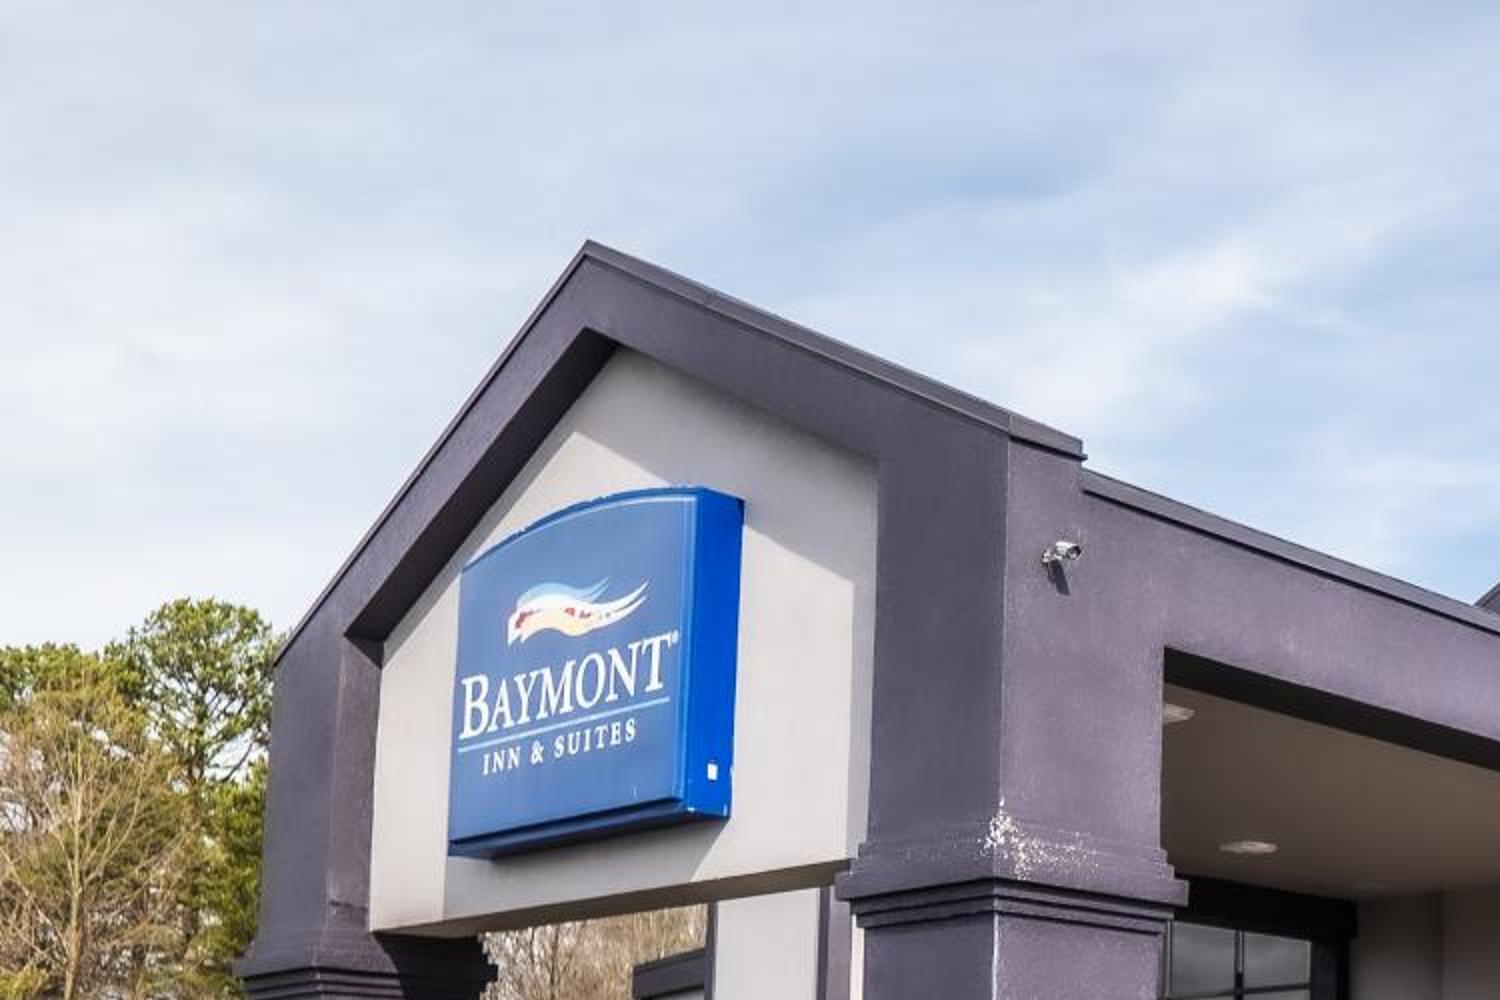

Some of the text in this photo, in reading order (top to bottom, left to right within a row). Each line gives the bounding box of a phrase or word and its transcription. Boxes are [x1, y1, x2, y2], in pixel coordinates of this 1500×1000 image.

[459, 633, 671, 740] BAYMONT
[482, 717, 637, 777] INN & SUITES
